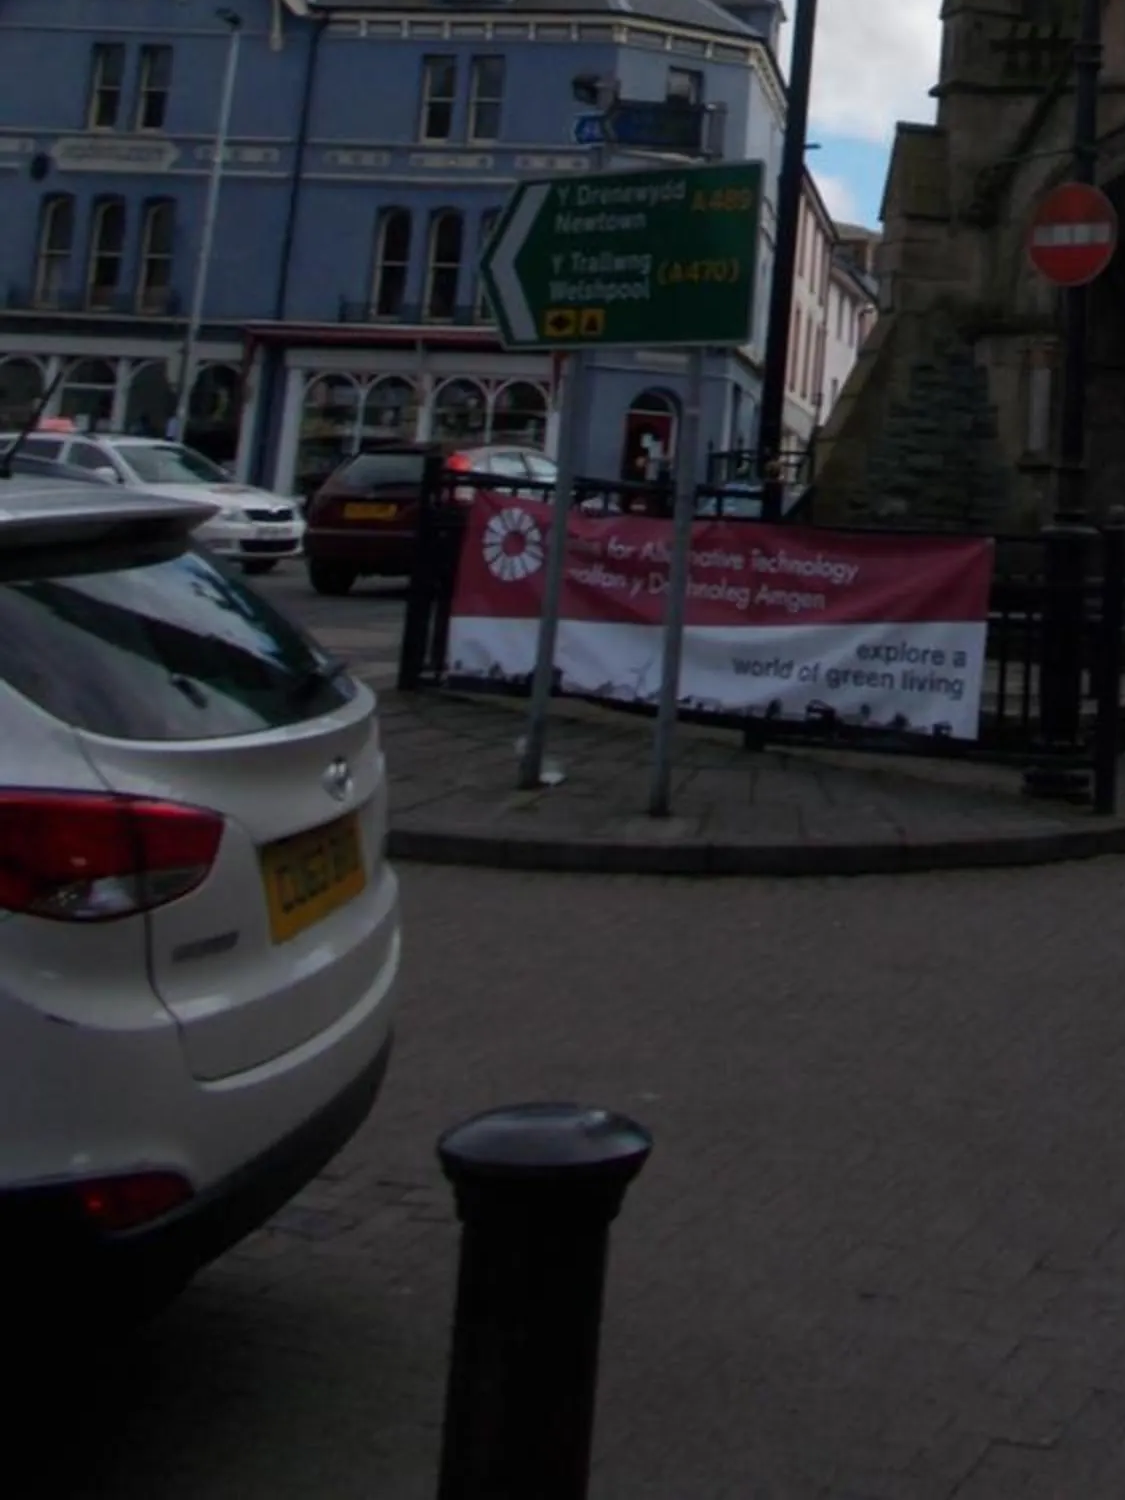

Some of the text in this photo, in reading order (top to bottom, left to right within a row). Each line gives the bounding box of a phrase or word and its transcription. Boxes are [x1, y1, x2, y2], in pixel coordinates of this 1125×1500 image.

[557, 185, 571, 206] Y
[556, 212, 647, 234] Newtown
[551, 254, 564, 275] Y
[608, 535, 637, 560] for
[753, 548, 859, 584] Technology
[755, 584, 825, 613] Amgen
[856, 641, 966, 668] explore a
[732, 657, 963, 700] world of green living
